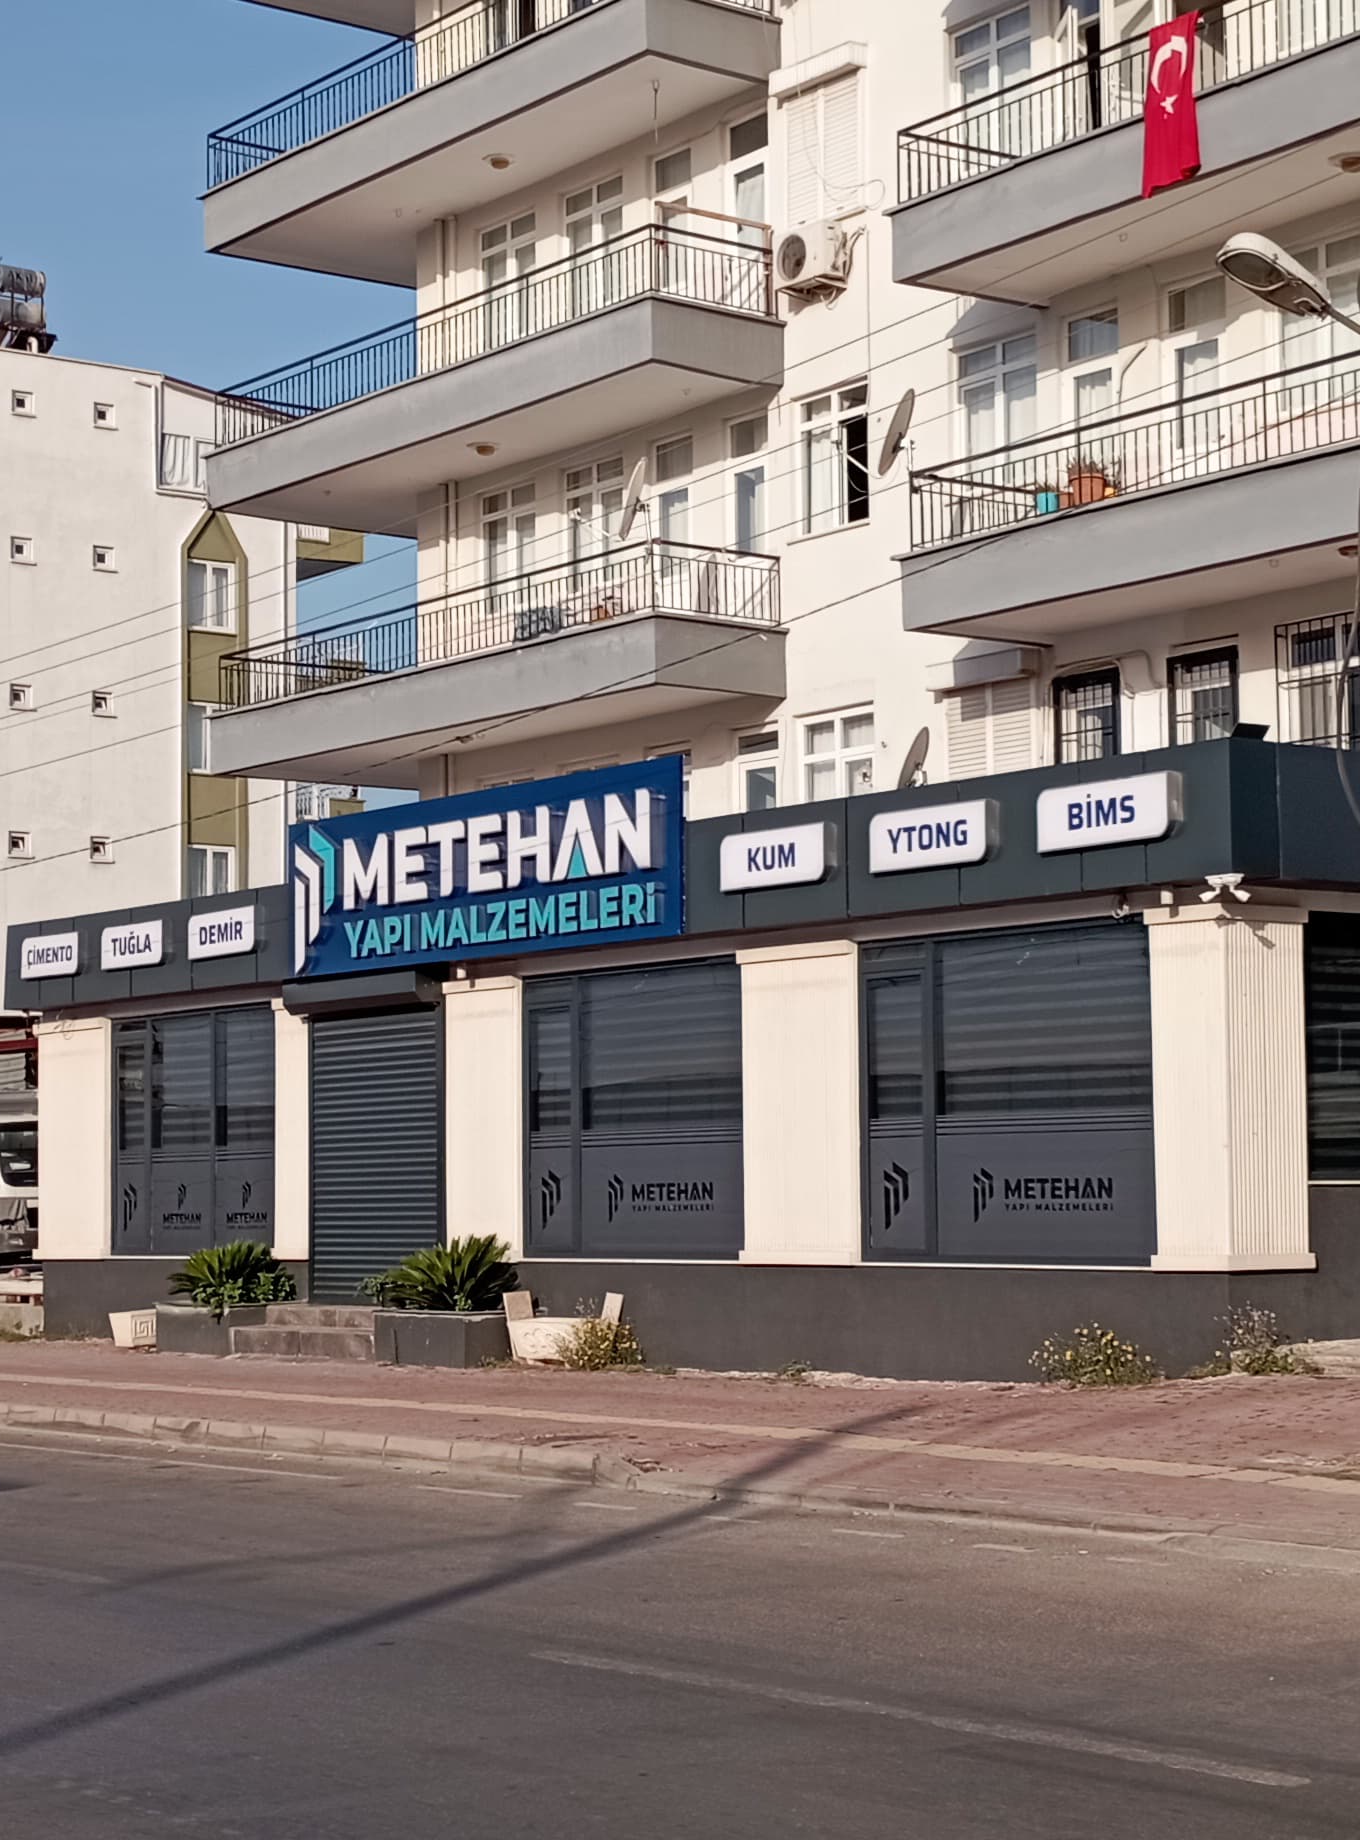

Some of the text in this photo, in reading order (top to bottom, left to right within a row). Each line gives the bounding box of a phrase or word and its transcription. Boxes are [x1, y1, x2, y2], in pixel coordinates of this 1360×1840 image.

[1067, 793, 1136, 831] BİMS
[342, 788, 653, 911] METEHAN
[887, 818, 969, 854] YTONG
[747, 842, 796, 872] KUM
[198, 916, 244, 946] DEMİR
[343, 881, 656, 958] YAPI MALZEMELERİ
[26, 944, 73, 970] ÇİMENTO
[111, 930, 153, 957] TUĞLA
[631, 1182, 714, 1202] METEHAN
[1003, 1177, 1113, 1200] METEHAN
[162, 1213, 202, 1225] METEHAN
[226, 1212, 268, 1224] METEHAN
[1004, 1203, 1030, 1212] YAPI
